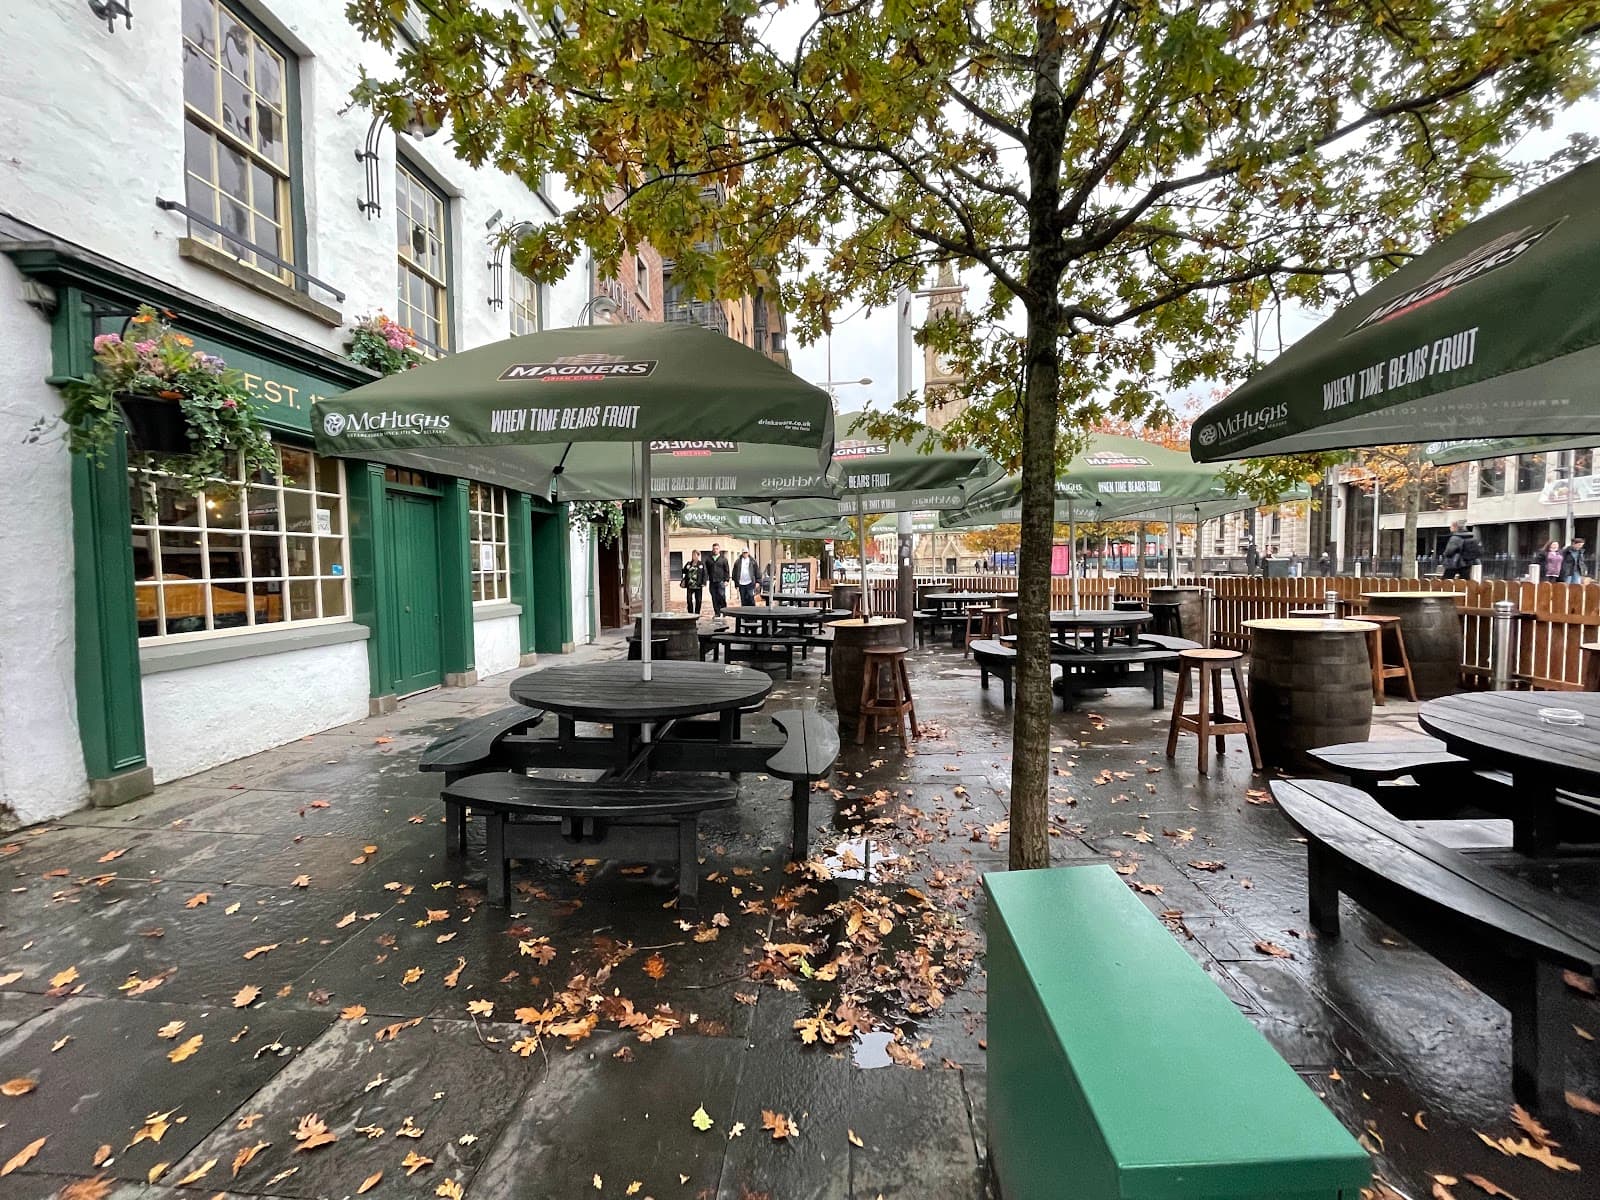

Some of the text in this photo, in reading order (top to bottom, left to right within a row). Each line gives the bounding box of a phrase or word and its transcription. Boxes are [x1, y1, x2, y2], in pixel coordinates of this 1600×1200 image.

[507, 363, 649, 377] MAGNERS
[1322, 327, 1479, 411] WHEN TIME BEARS FRUIT
[244, 372, 301, 410] EST.
[490, 405, 641, 433] WHEN TIME BEARS FRUIT
[833, 445, 887, 456] GNERS
[848, 473, 891, 489] BEARS FRUIT
[1097, 481, 1161, 493] WHEN TIME BEARS FRUIT
[782, 573, 801, 583] FOOD
